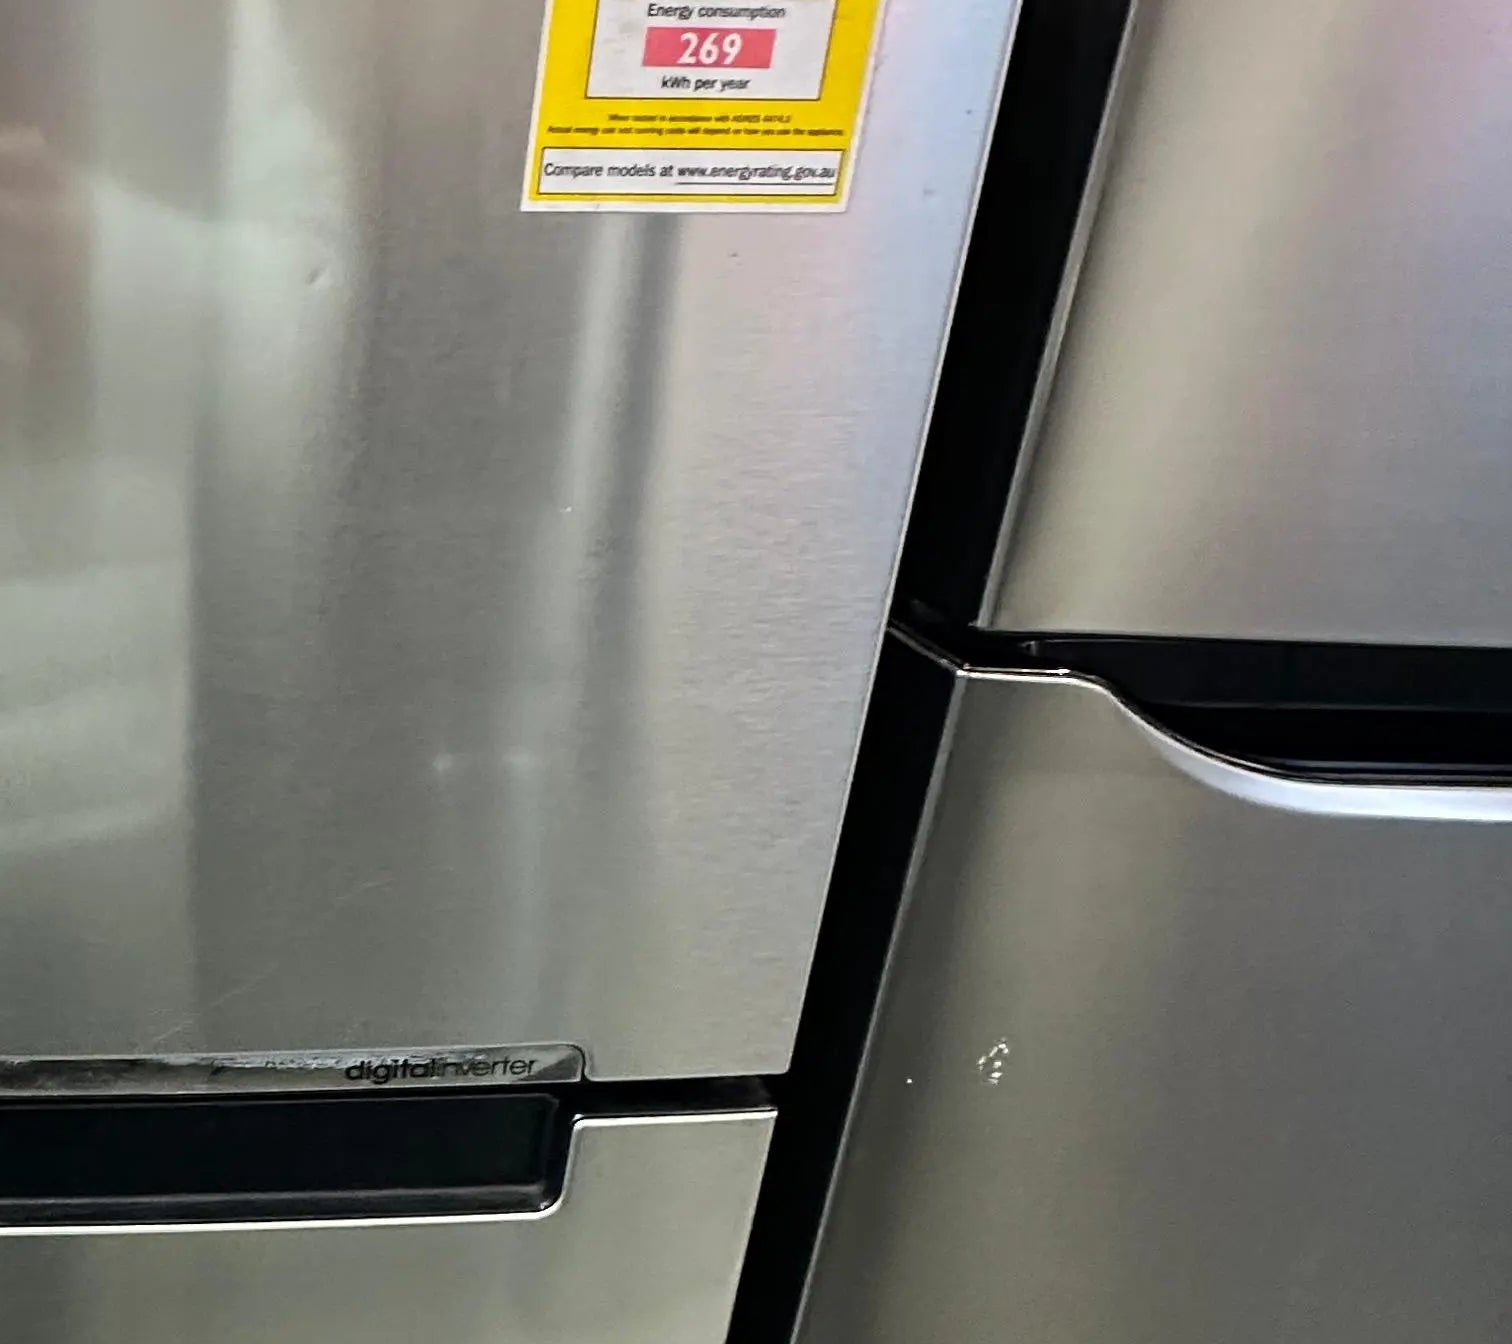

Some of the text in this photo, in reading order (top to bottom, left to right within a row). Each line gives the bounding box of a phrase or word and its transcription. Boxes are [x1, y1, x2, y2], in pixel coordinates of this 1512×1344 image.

[647, 3, 786, 21] Energy consumption
[676, 32, 742, 65] 269
[661, 76, 751, 91] kWh per year
[544, 163, 604, 179] Compare
[607, 164, 656, 177] models
[659, 164, 674, 177] at
